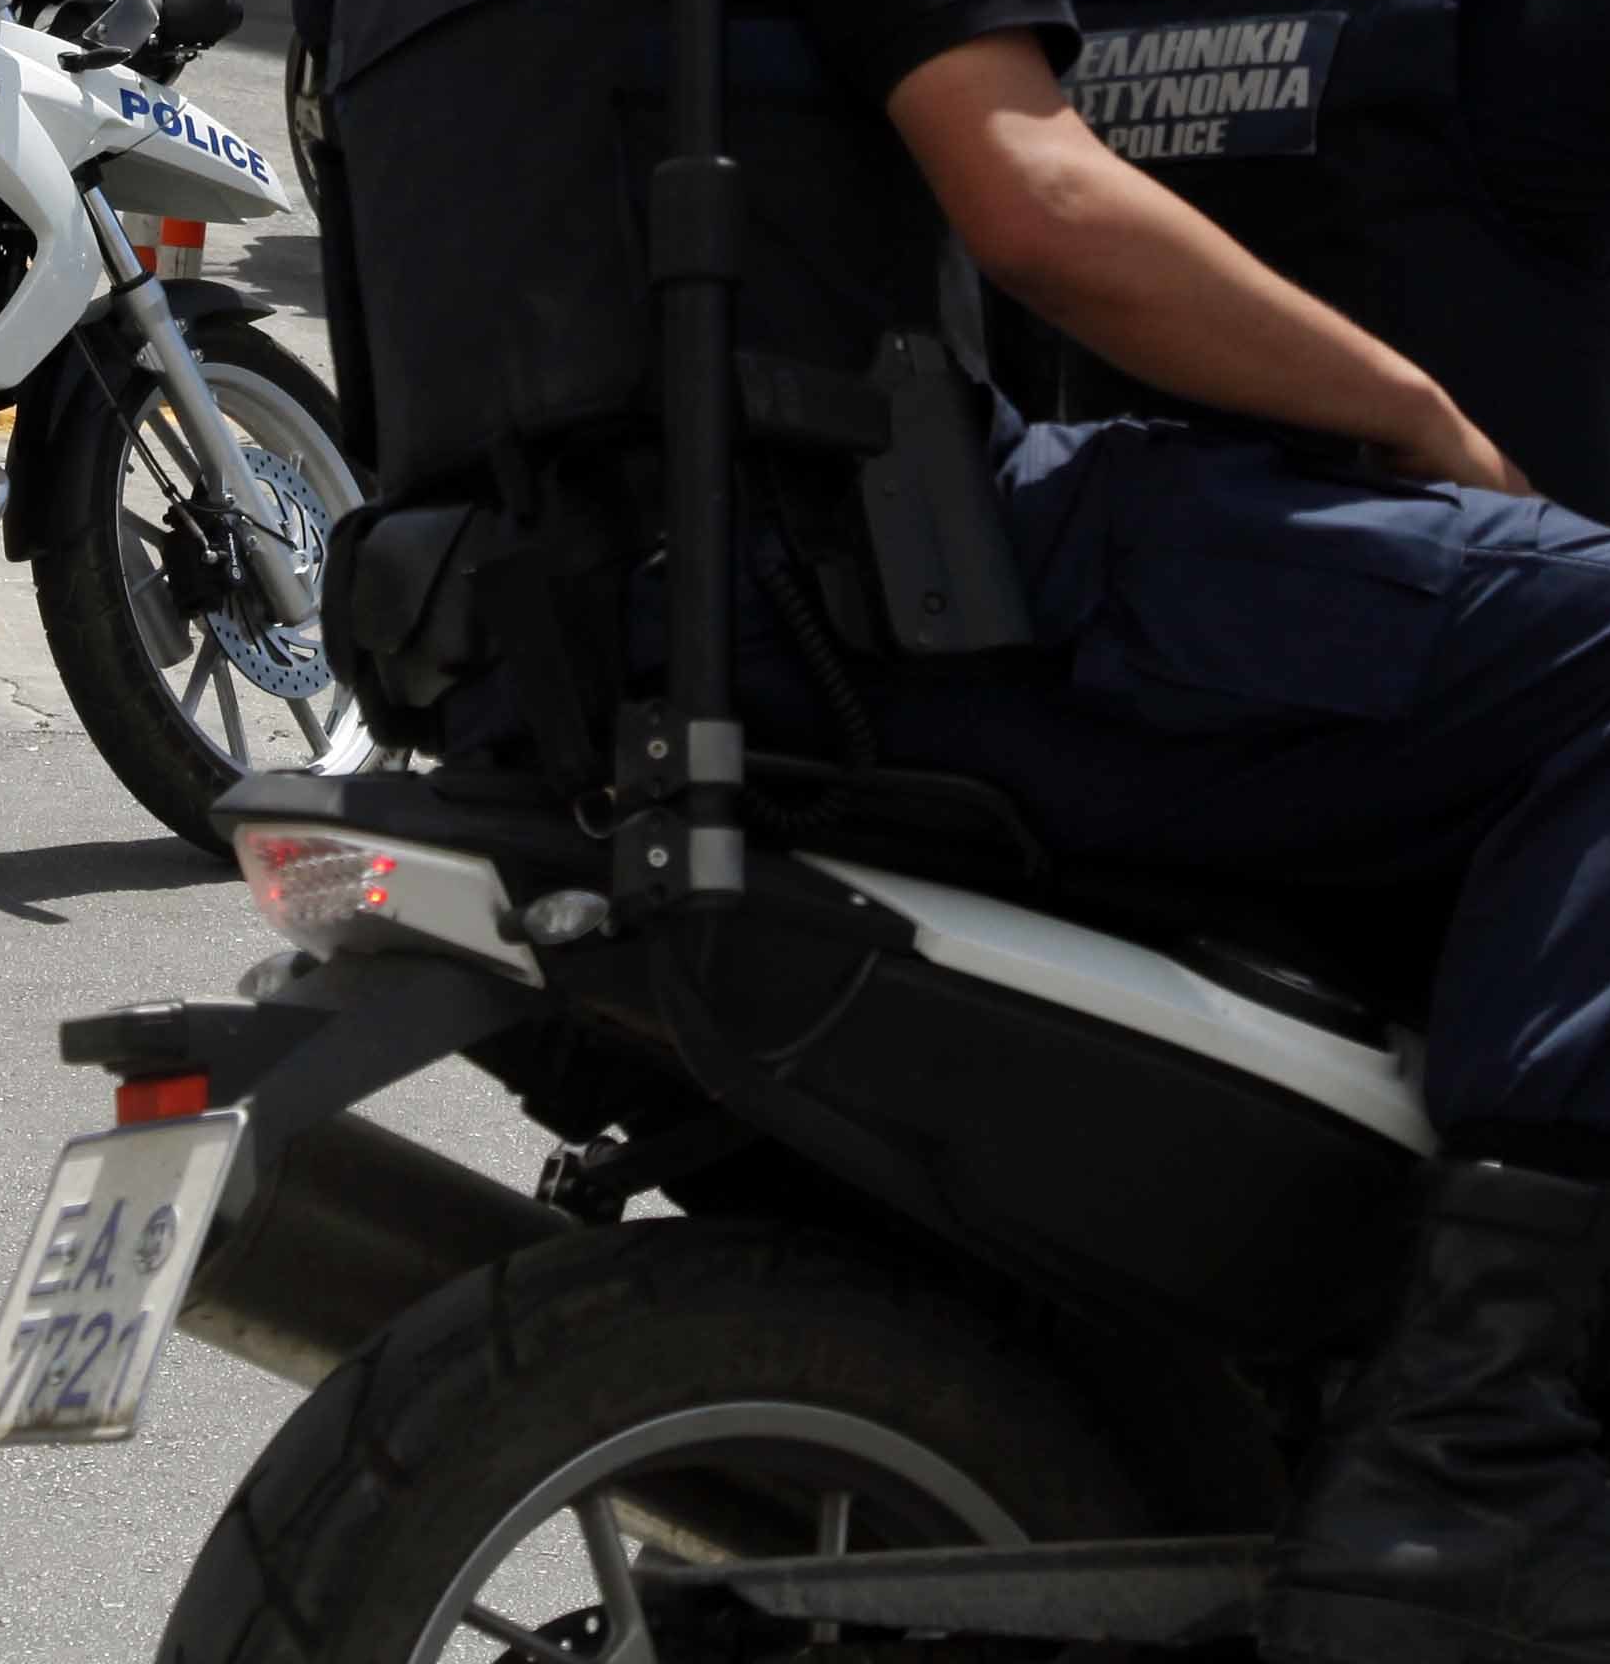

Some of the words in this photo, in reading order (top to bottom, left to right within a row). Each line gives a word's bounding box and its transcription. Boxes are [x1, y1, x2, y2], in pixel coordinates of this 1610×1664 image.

[1075, 20, 1307, 79] ΕΛΛΗΝΙΚΗ
[119, 87, 270, 185] POLICE
[1108, 119, 1229, 160] POLICE
